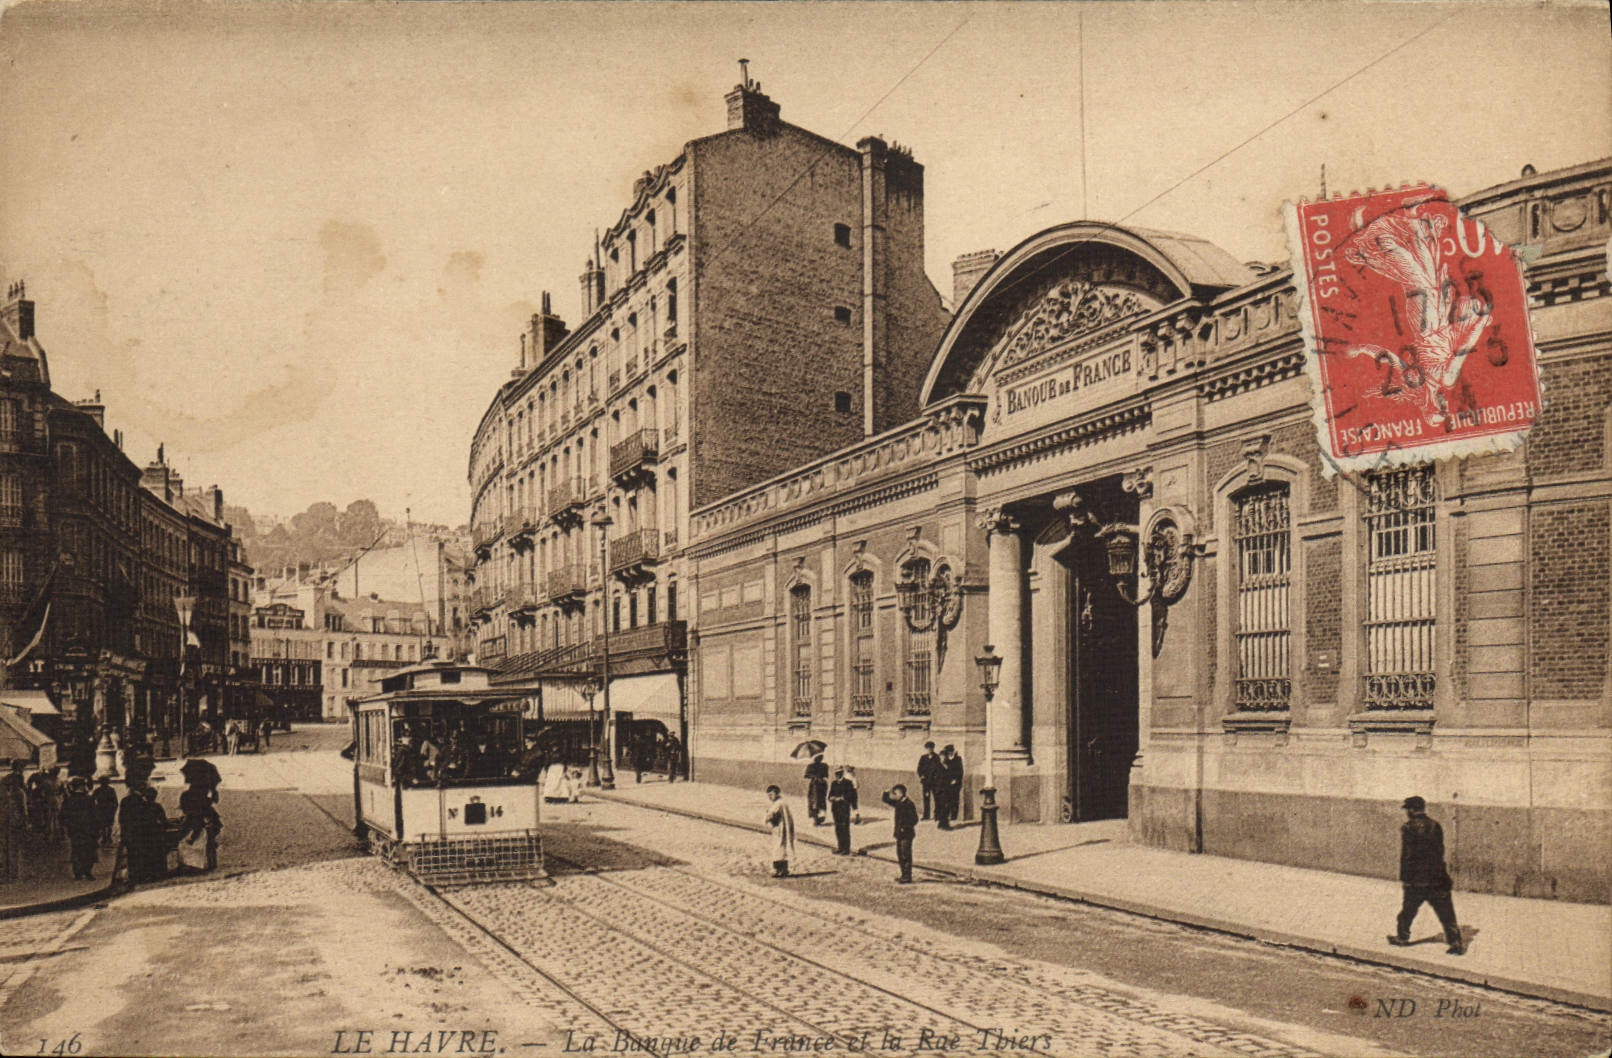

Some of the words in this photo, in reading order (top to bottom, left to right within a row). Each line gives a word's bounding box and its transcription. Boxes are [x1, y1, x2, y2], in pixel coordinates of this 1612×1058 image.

[1310, 214, 1338, 299] POSTES
[1007, 379, 1057, 414] BANQUE
[1073, 350, 1131, 391] FRANCE
[1450, 401, 1535, 430] REPUBLIQUE
